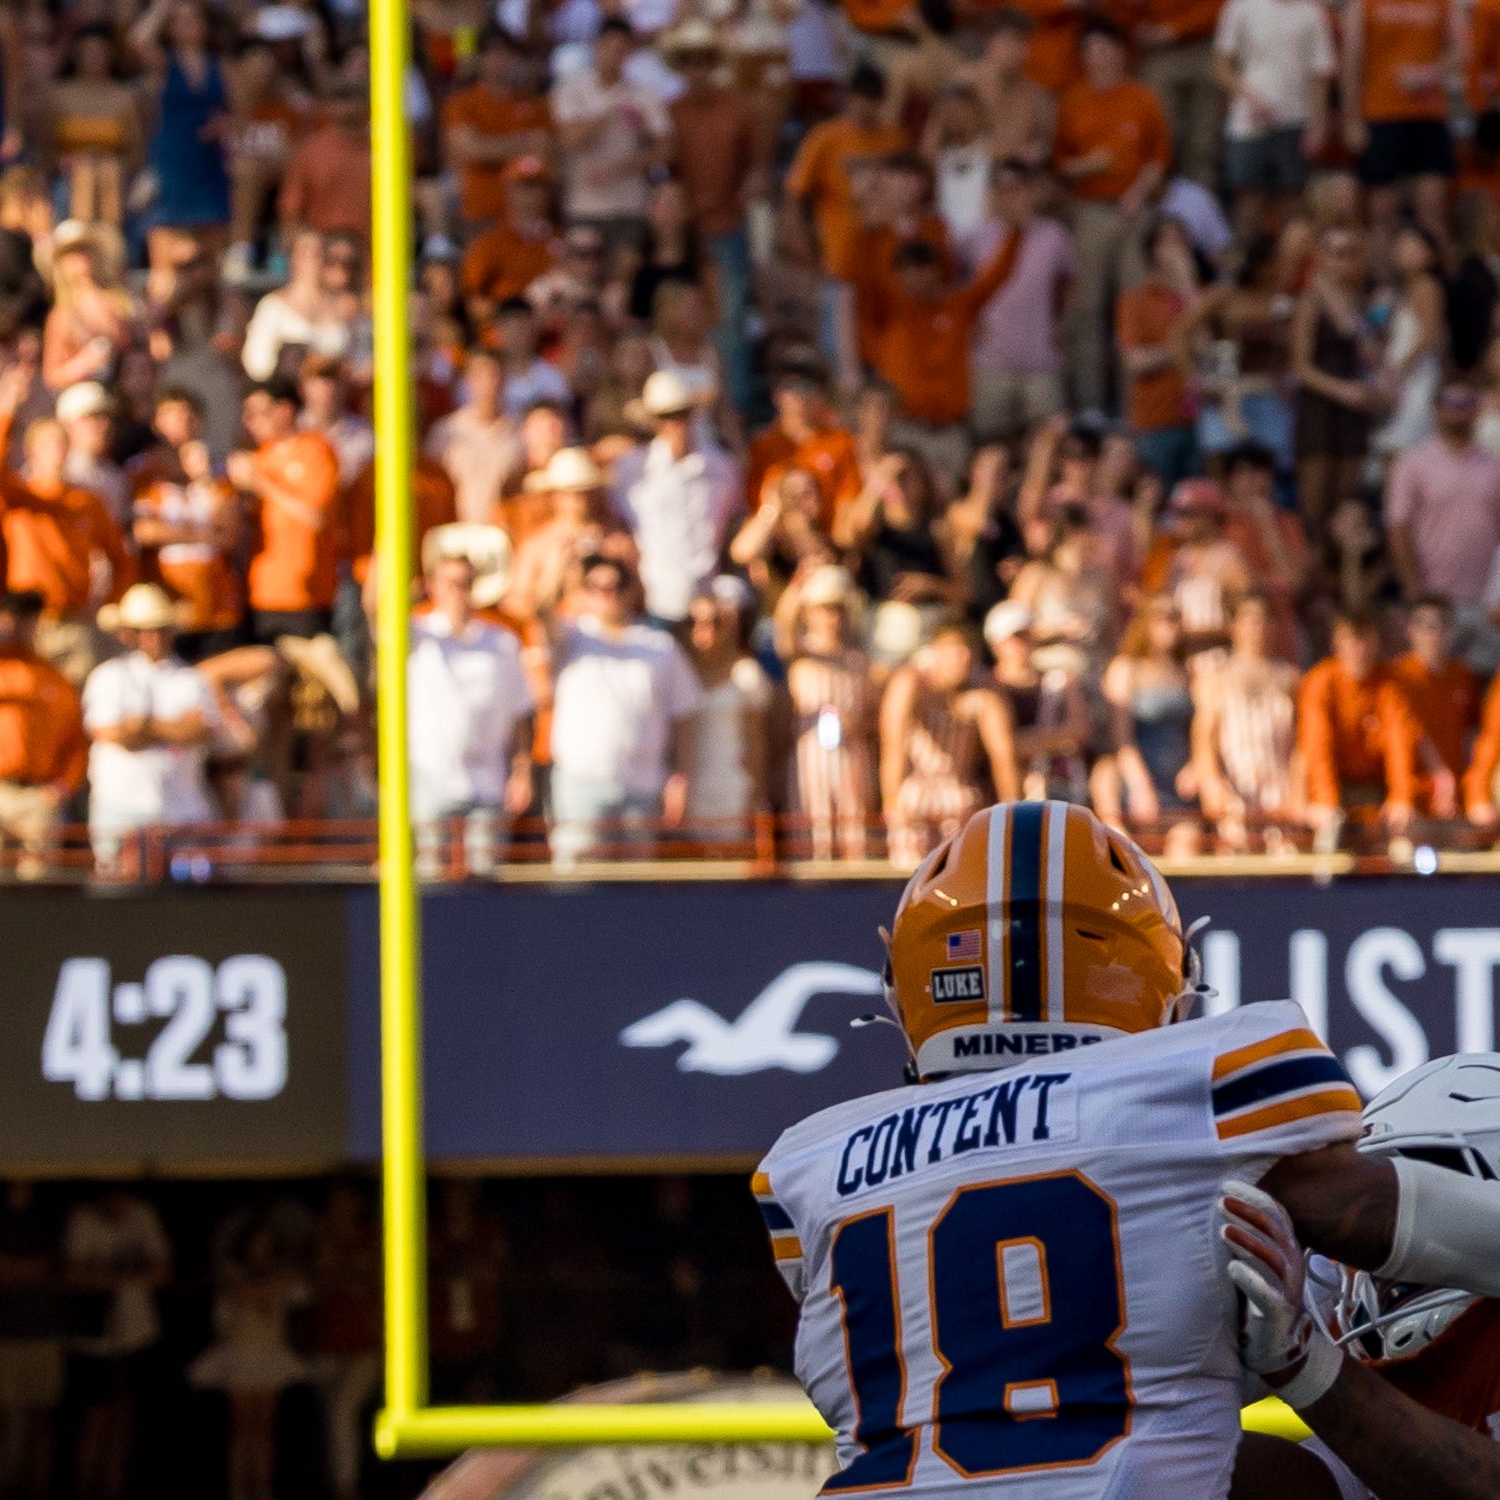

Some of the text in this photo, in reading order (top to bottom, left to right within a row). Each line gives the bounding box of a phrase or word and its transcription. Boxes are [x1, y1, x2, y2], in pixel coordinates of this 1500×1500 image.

[41, 955, 289, 1102] 4:23
[933, 970, 983, 999] LUKE
[836, 1073, 1072, 1196] CONTENT
[817, 1168, 1136, 1496] 18
